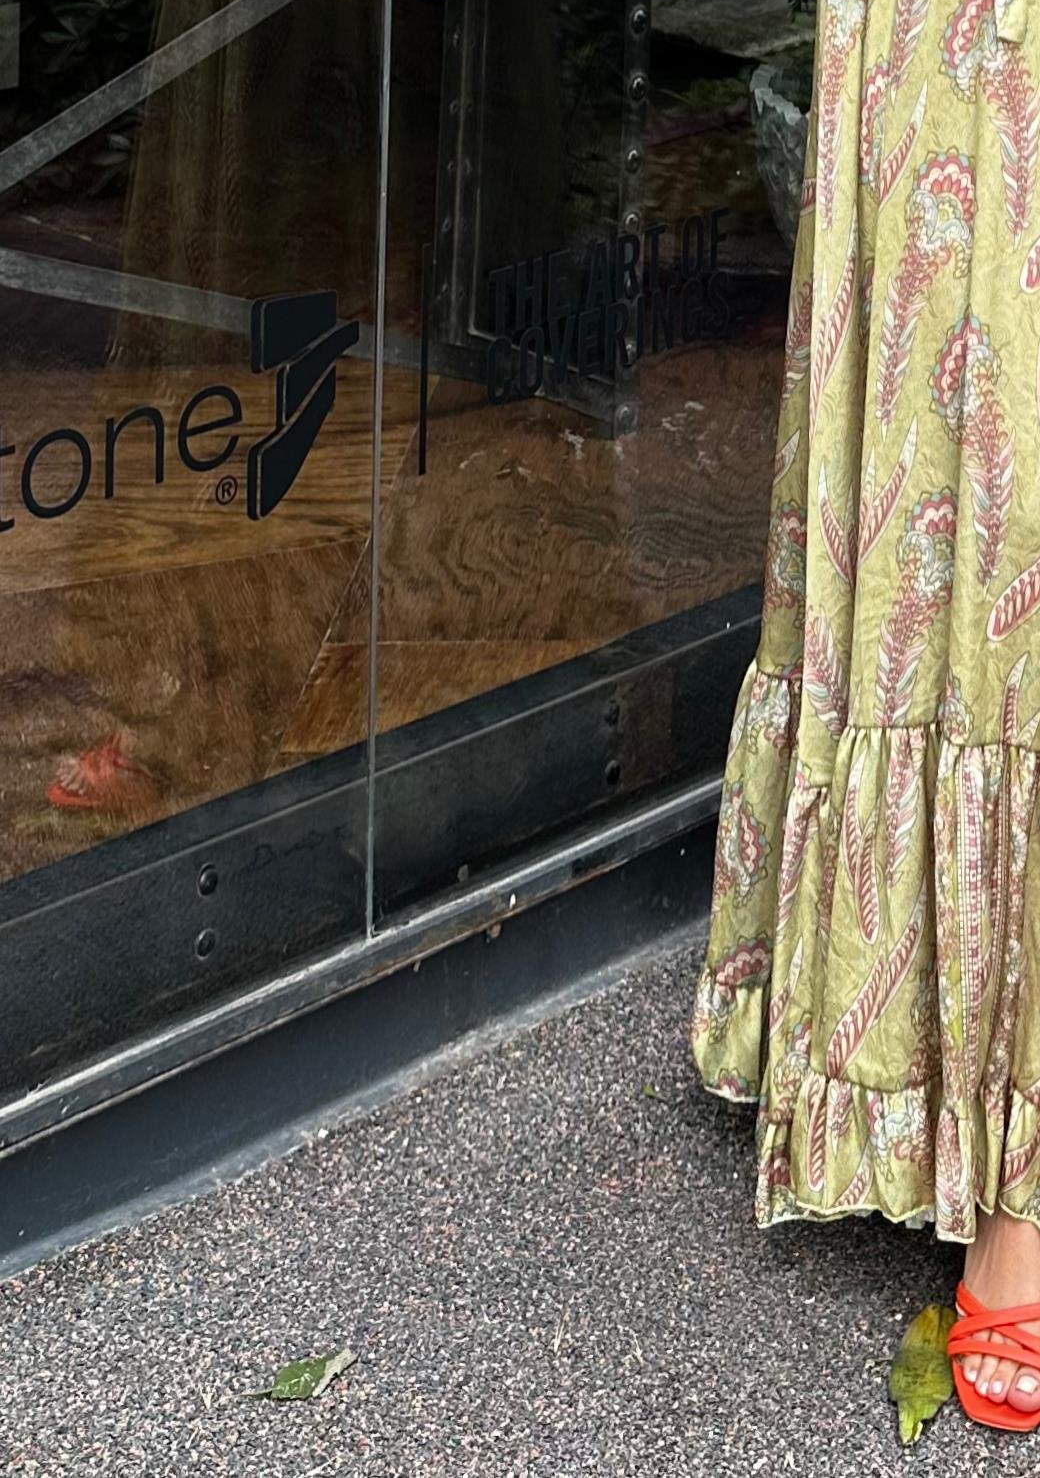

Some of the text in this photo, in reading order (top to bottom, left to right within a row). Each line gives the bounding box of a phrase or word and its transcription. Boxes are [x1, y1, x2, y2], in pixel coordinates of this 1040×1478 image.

[487, 206, 731, 337] THE ART OF
[486, 271, 732, 405] COVERINGS
